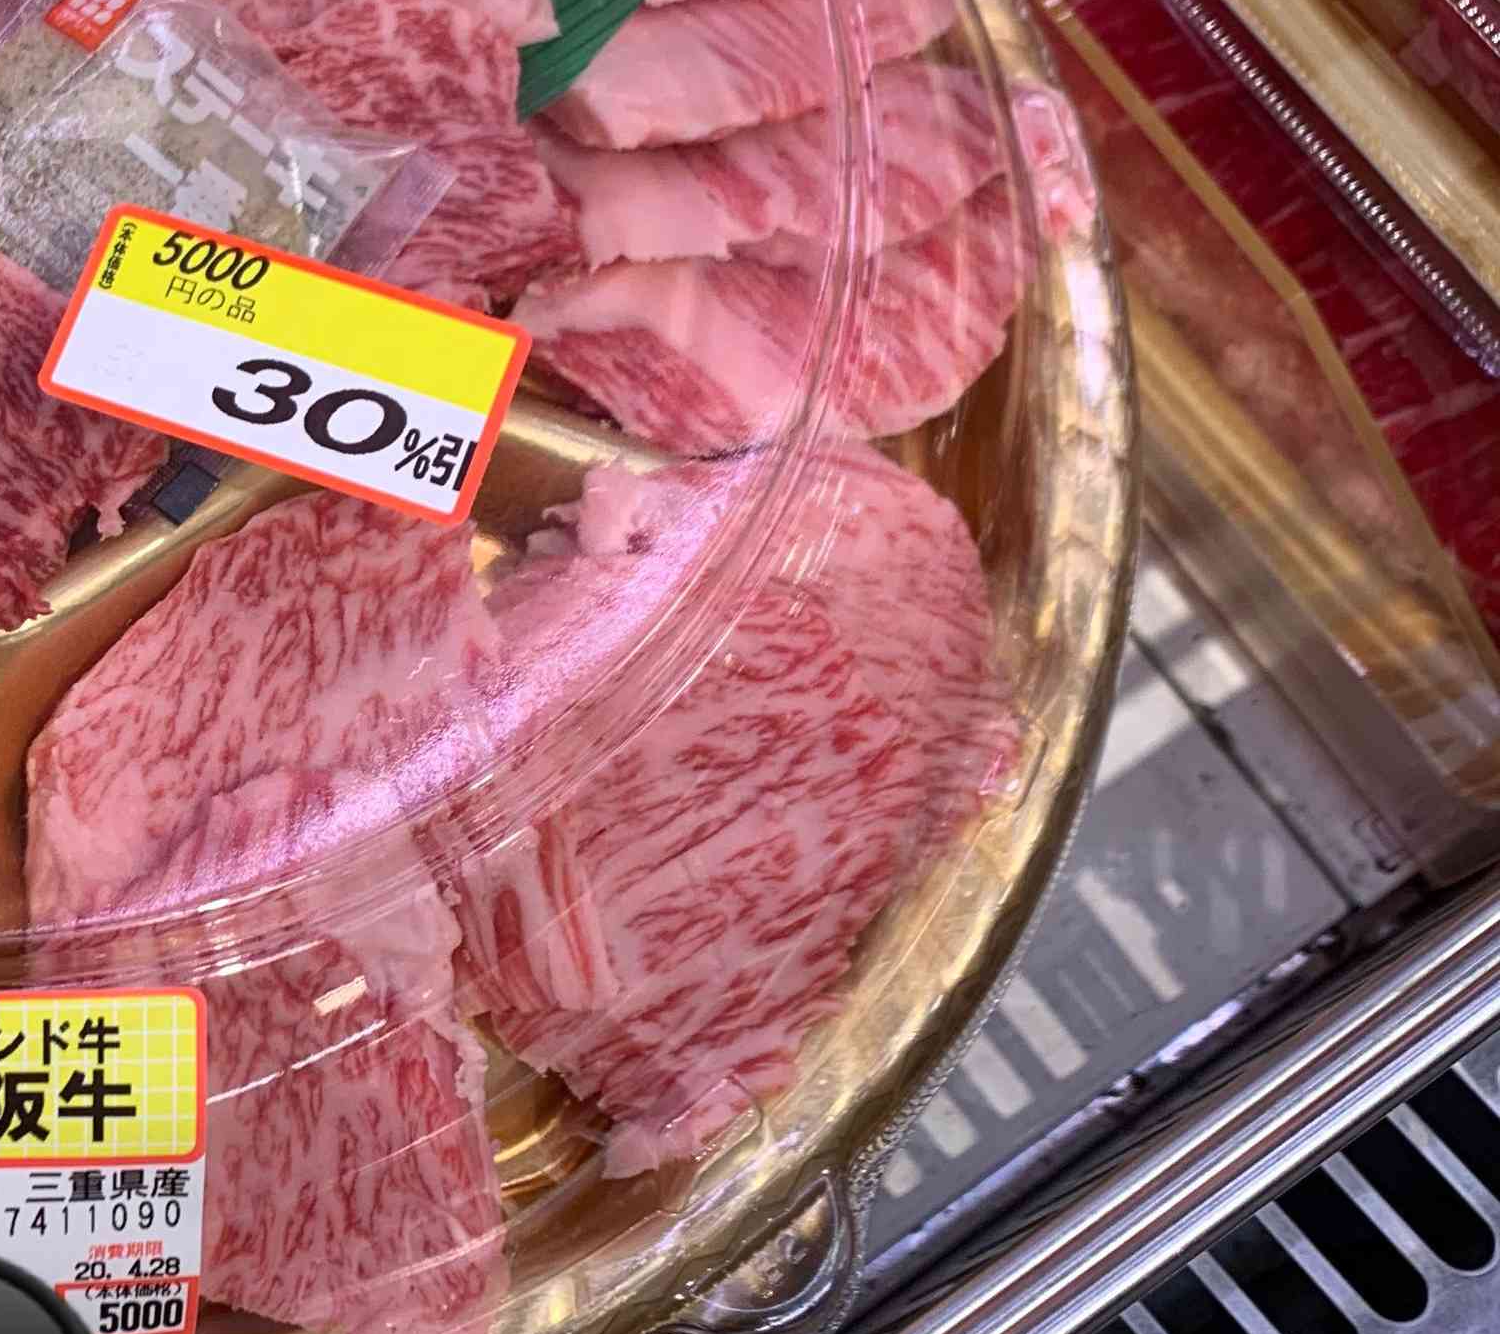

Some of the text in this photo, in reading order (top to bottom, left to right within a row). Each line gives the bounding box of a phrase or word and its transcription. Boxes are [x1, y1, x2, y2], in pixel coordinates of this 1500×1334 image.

[153, 229, 271, 292] 5000
[165, 276, 257, 324] 円の品
[211, 358, 478, 492] 30%引
[25, 1166, 190, 1205] 三重県産
[88, 1240, 164, 1259] 消費期限
[99, 1298, 184, 1334] 5000
